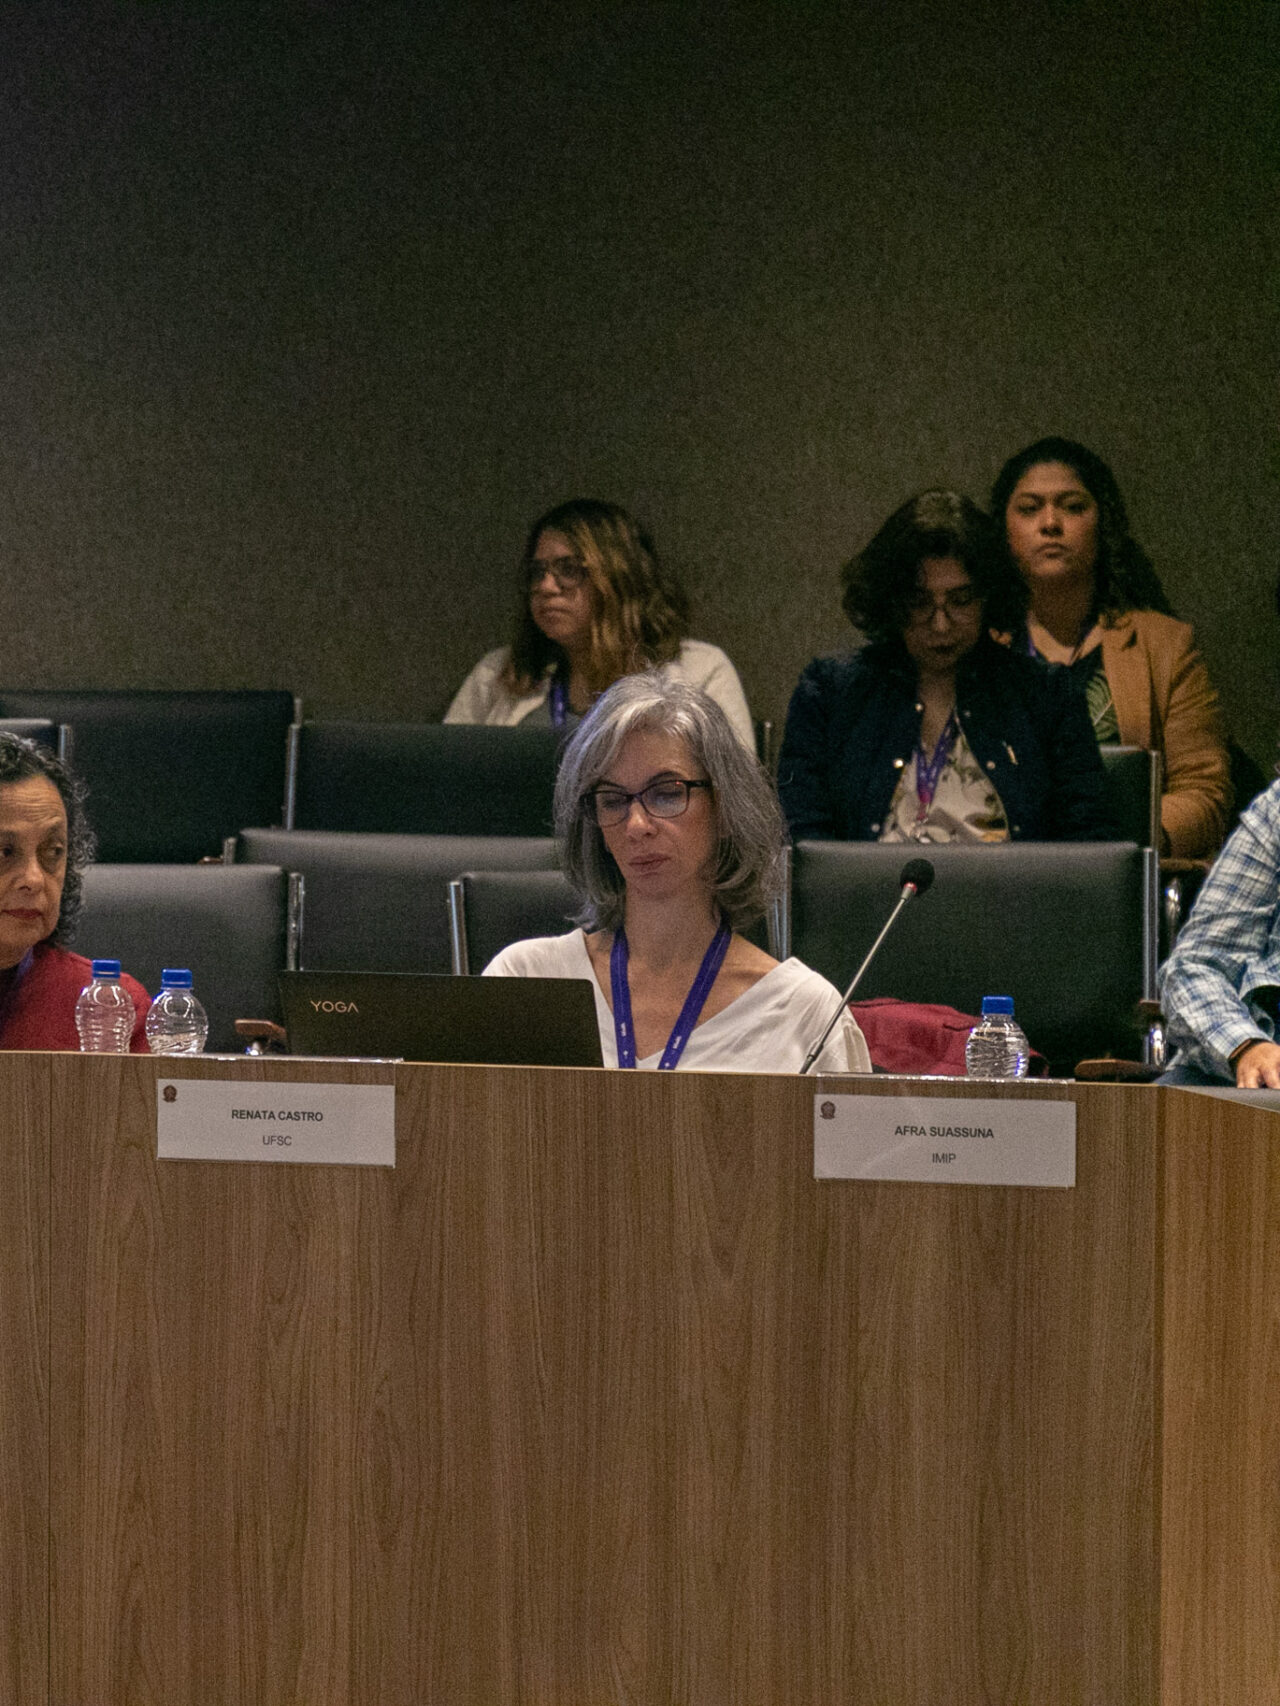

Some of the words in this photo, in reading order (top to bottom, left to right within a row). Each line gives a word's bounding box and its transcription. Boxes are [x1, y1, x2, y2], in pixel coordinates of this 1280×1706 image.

[310, 1000, 359, 1013] YOGA
[231, 1109, 275, 1120] RENATA
[278, 1111, 324, 1122] CASTRO
[894, 1125, 927, 1136] AFRA
[930, 1127, 995, 1138] SUASSUNA
[262, 1135, 292, 1146] UFSC
[932, 1153, 957, 1164] IMIP
